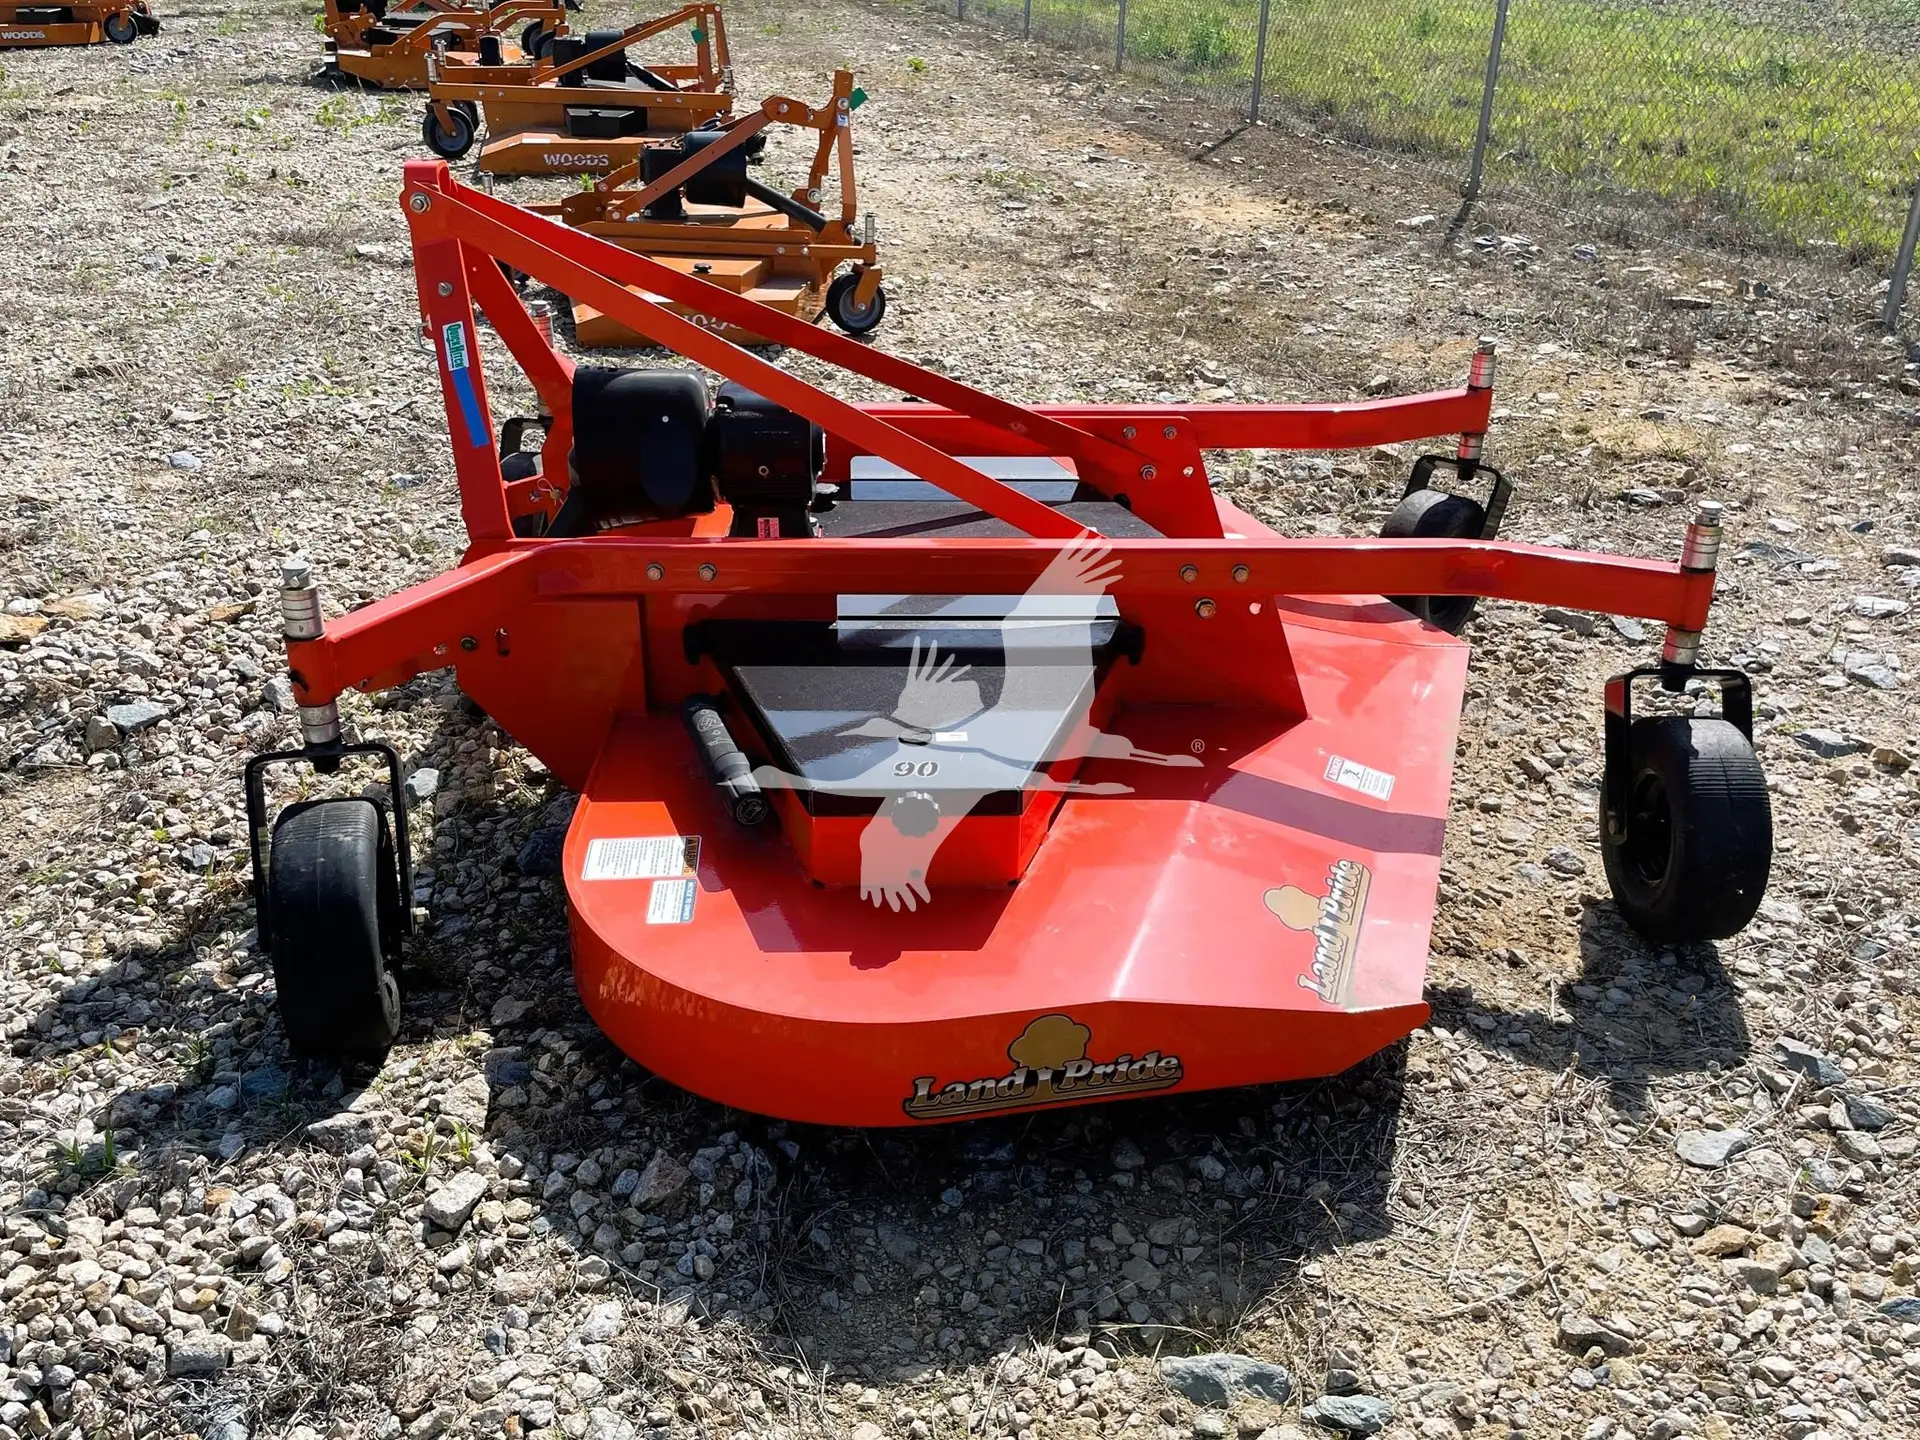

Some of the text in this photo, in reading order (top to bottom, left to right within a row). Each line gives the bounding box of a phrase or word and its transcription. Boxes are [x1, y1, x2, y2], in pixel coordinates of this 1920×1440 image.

[1, 31, 46, 39] WOODS
[543, 153, 609, 166] WOODS
[892, 760, 940, 777] 90
[1298, 859, 1360, 1000] Land Pride
[909, 1051, 1181, 1108] Land Pride
